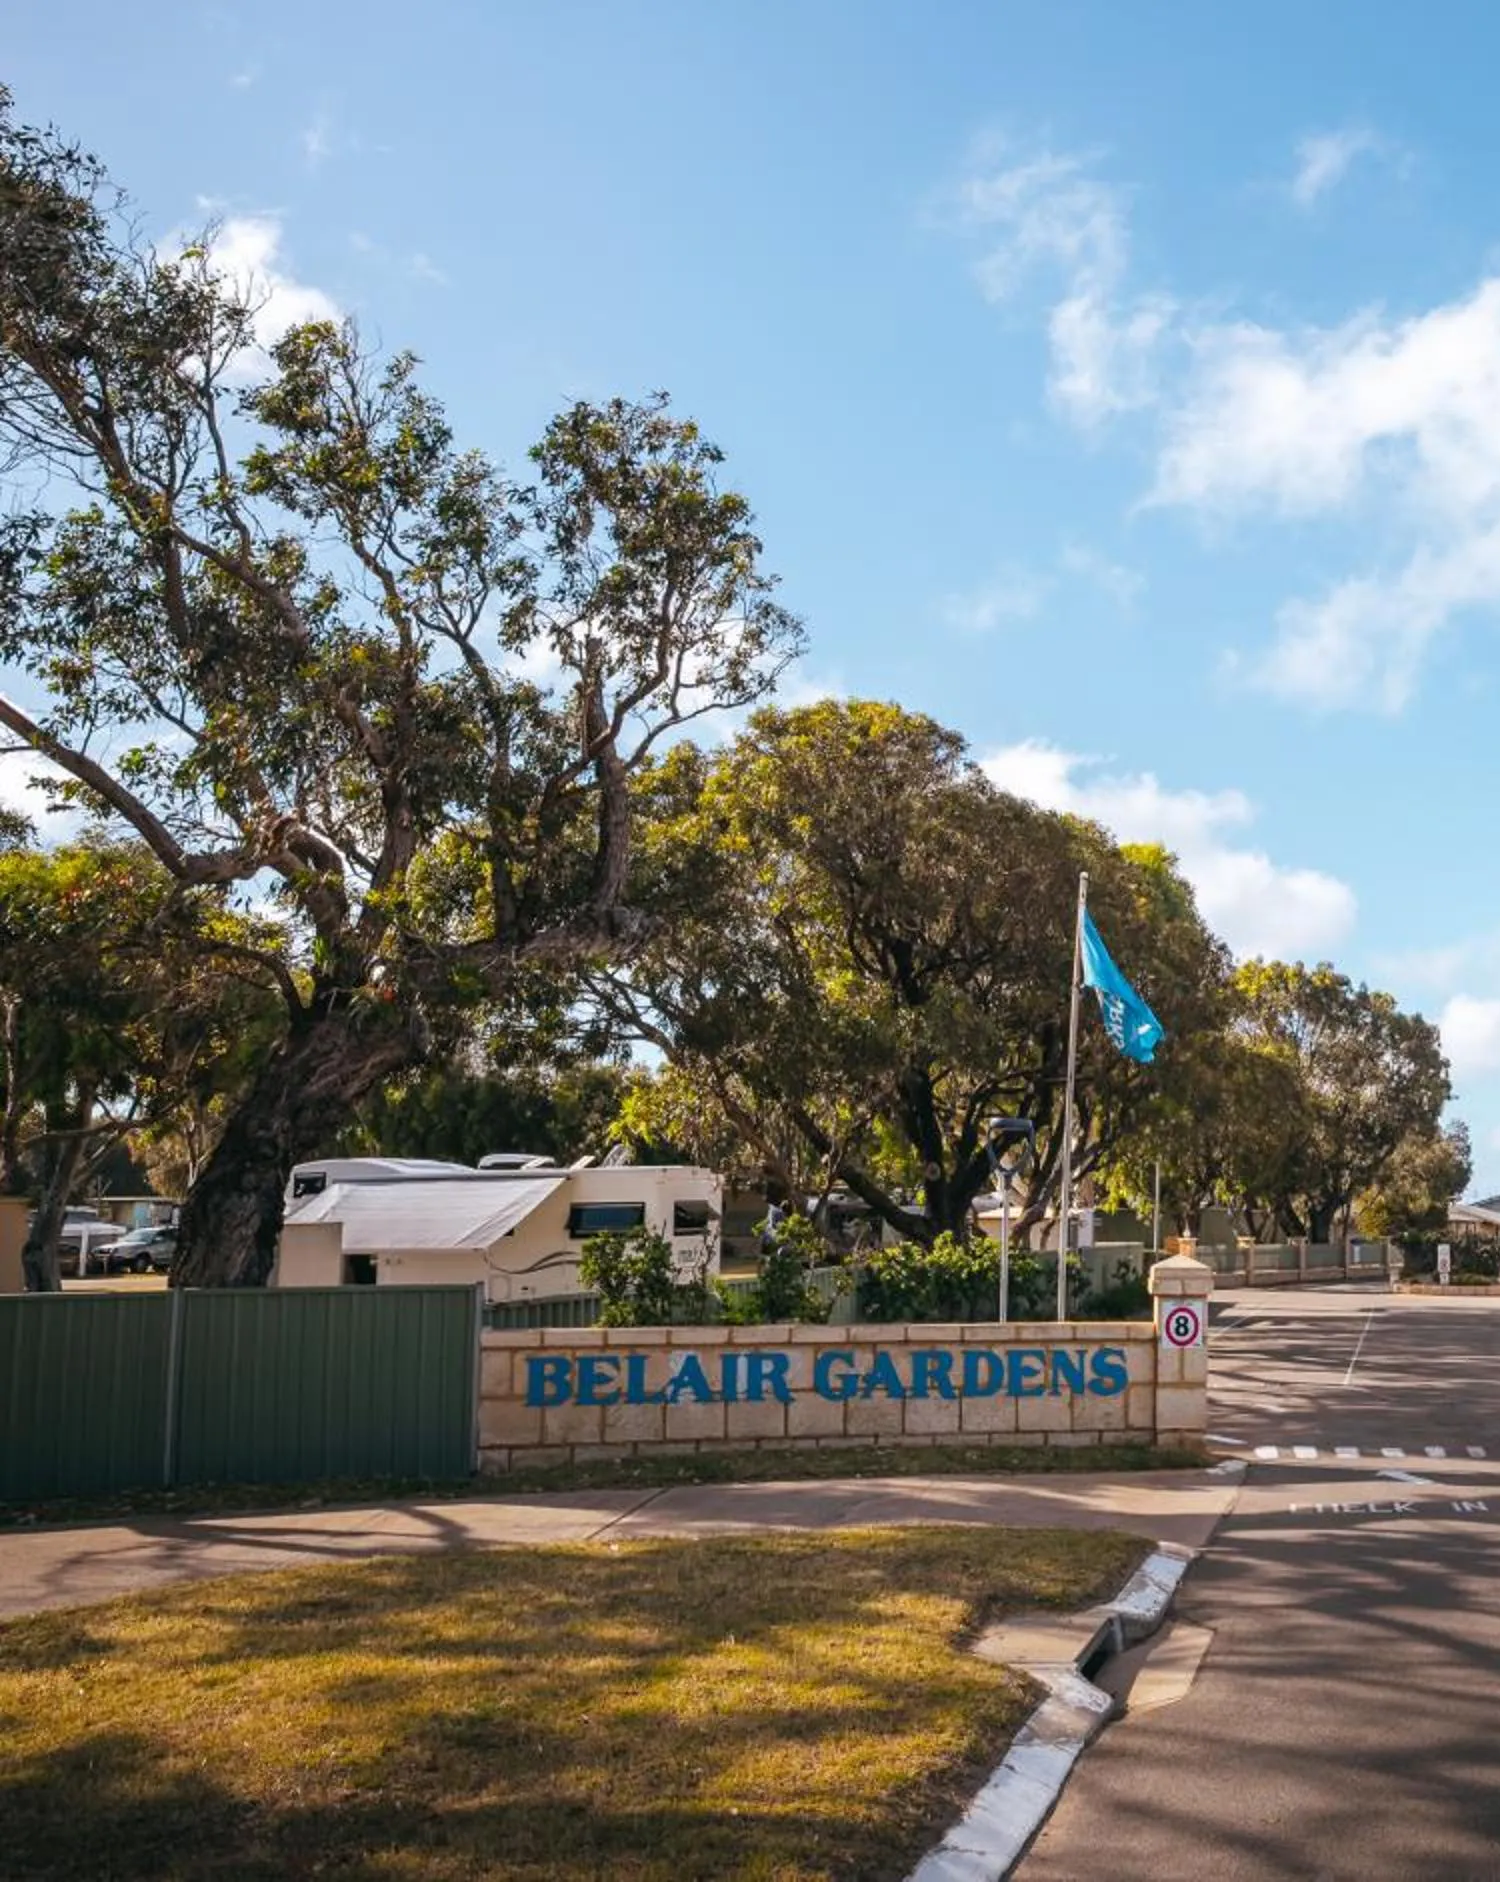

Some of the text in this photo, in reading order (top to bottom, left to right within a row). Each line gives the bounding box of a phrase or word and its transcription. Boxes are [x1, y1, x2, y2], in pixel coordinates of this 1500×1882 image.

[1175, 1315, 1189, 1337] 8
[525, 1347, 1129, 1407] BELAIR GARDENS
[1451, 1501, 1489, 1513] IN
